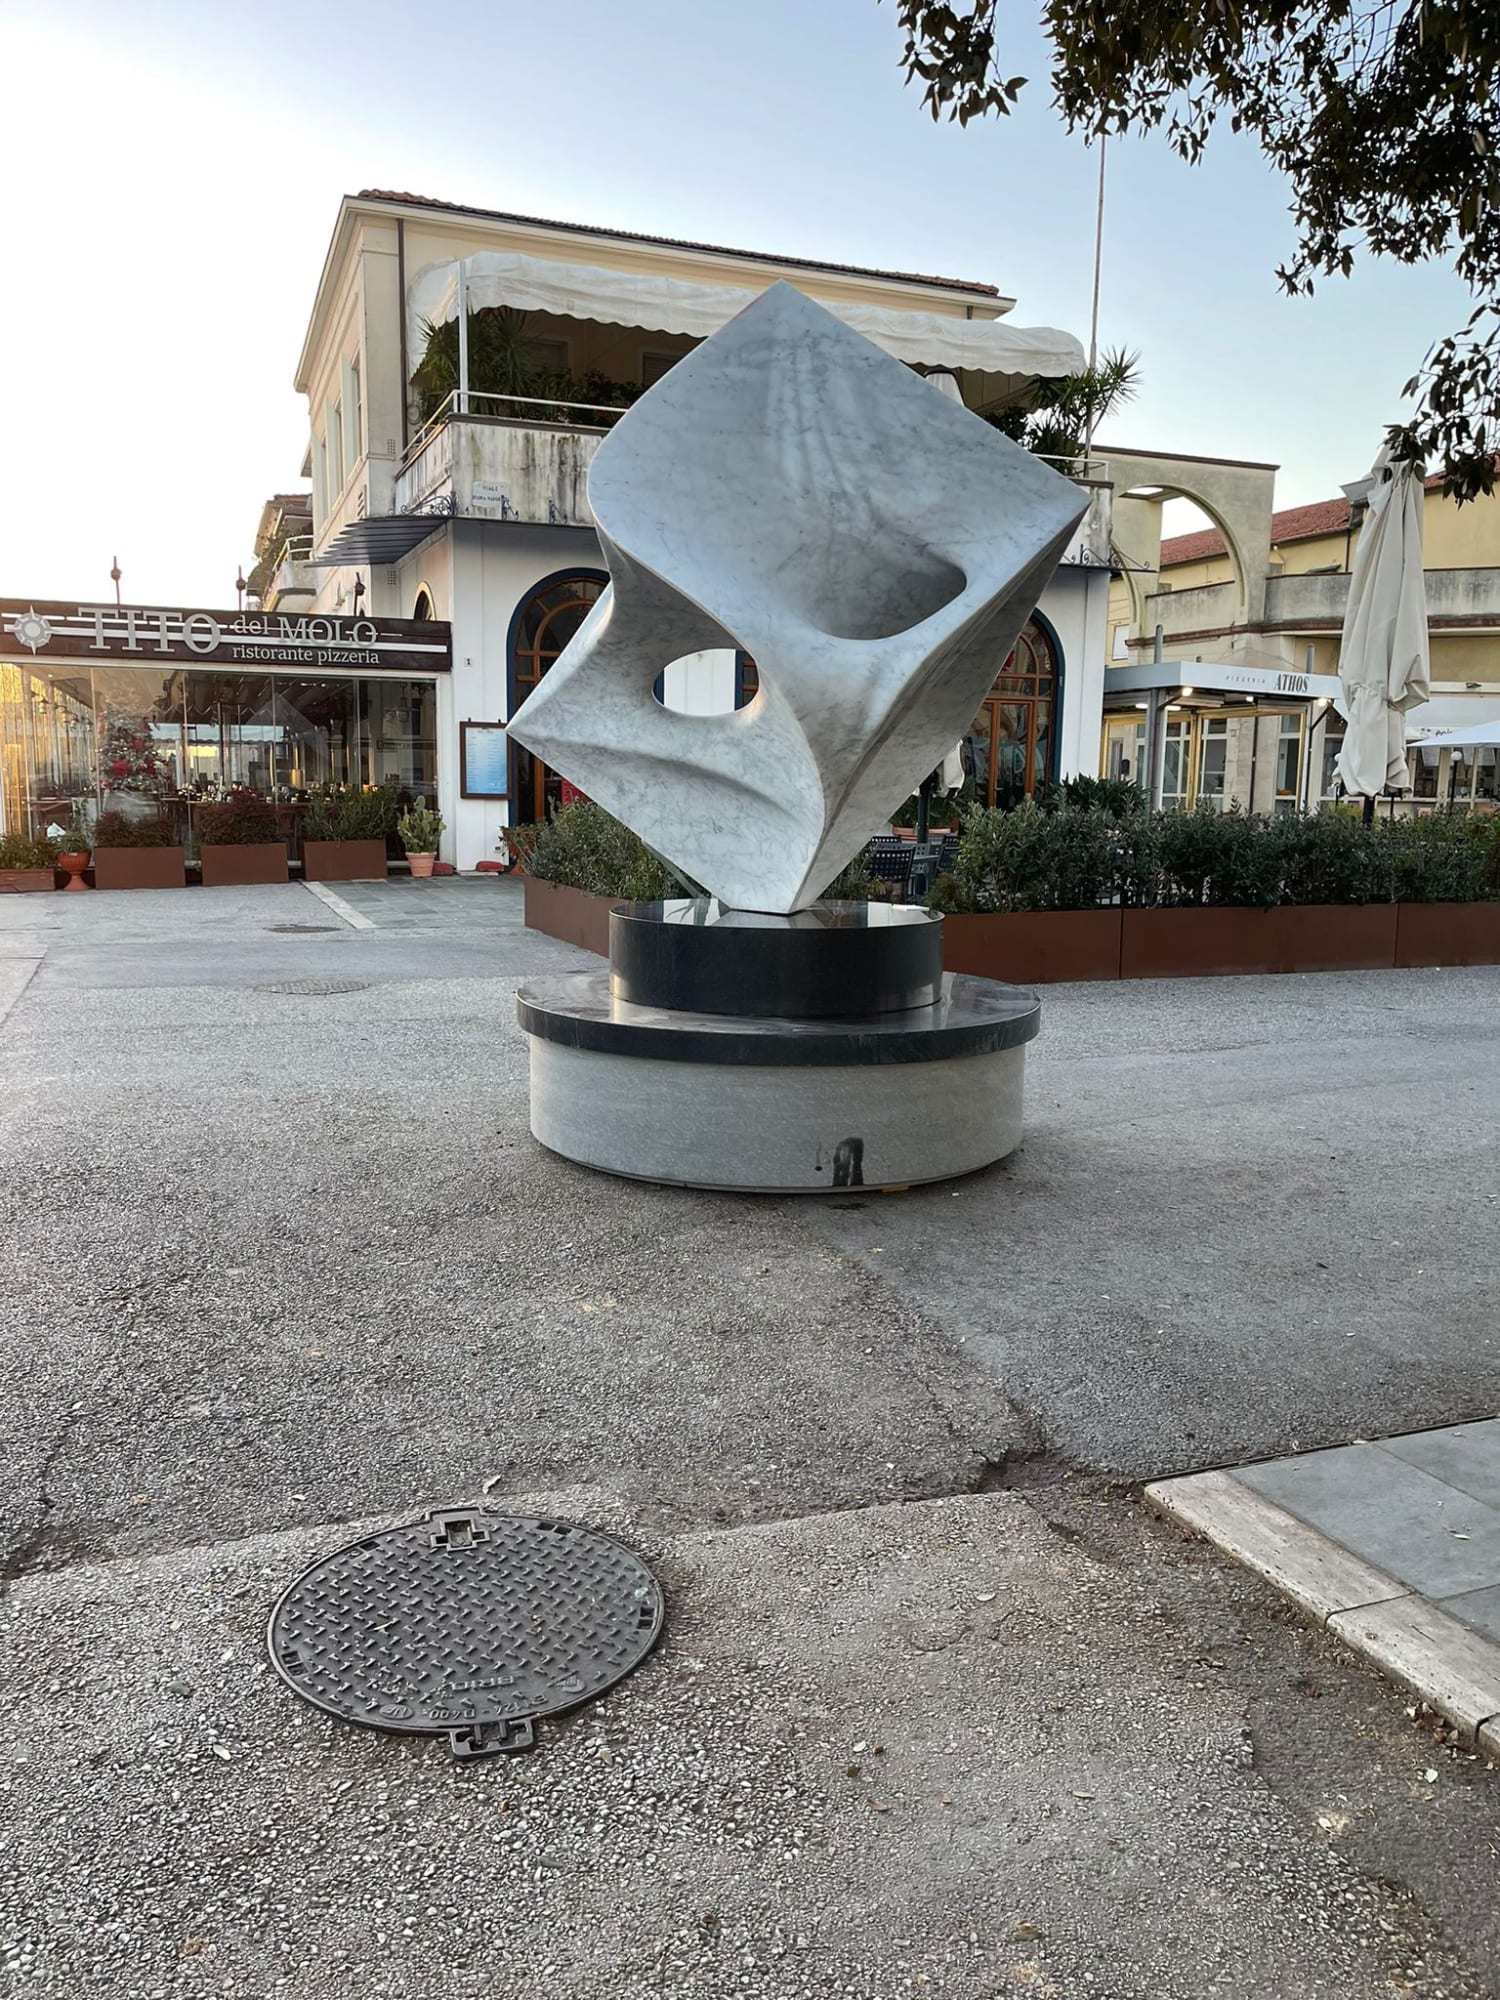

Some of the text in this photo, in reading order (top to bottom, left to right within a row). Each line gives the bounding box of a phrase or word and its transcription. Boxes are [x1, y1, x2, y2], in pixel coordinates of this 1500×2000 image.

[78, 607, 221, 653] TITO
[233, 615, 377, 647] del MOLO
[232, 645, 380, 665] ristorante pizzeria
[1275, 673, 1310, 693] ATHOS
